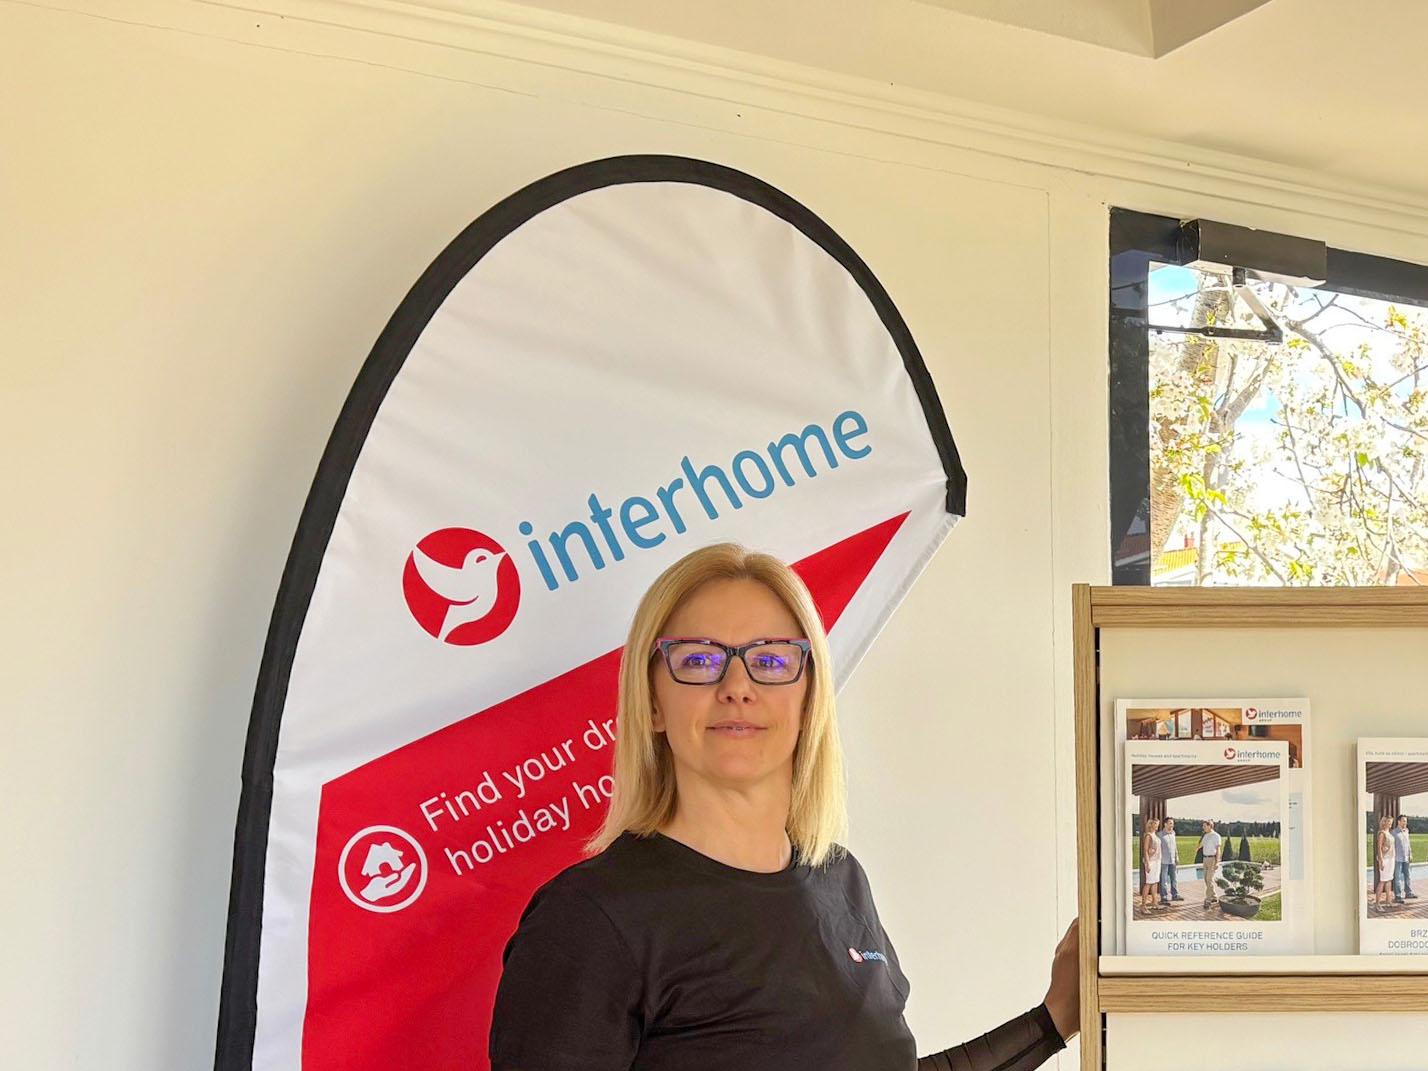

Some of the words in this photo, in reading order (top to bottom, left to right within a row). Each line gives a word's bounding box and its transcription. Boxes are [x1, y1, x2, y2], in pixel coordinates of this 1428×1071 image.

[519, 410, 872, 591] interhome
[1258, 708, 1302, 718] interhome
[1237, 749, 1281, 759] interhome
[419, 771, 502, 832] Find
[502, 738, 576, 798] your
[583, 717, 619, 751] dr
[444, 797, 571, 876] holiday
[572, 775, 616, 810] ho
[1152, 931, 1179, 941] QUICK
[1181, 931, 1234, 940] REFERENCE
[1236, 931, 1263, 940] GUIDE
[1168, 942, 1185, 951] FOR
[1187, 942, 1204, 951] KEY
[1206, 942, 1248, 951] HOLDERS
